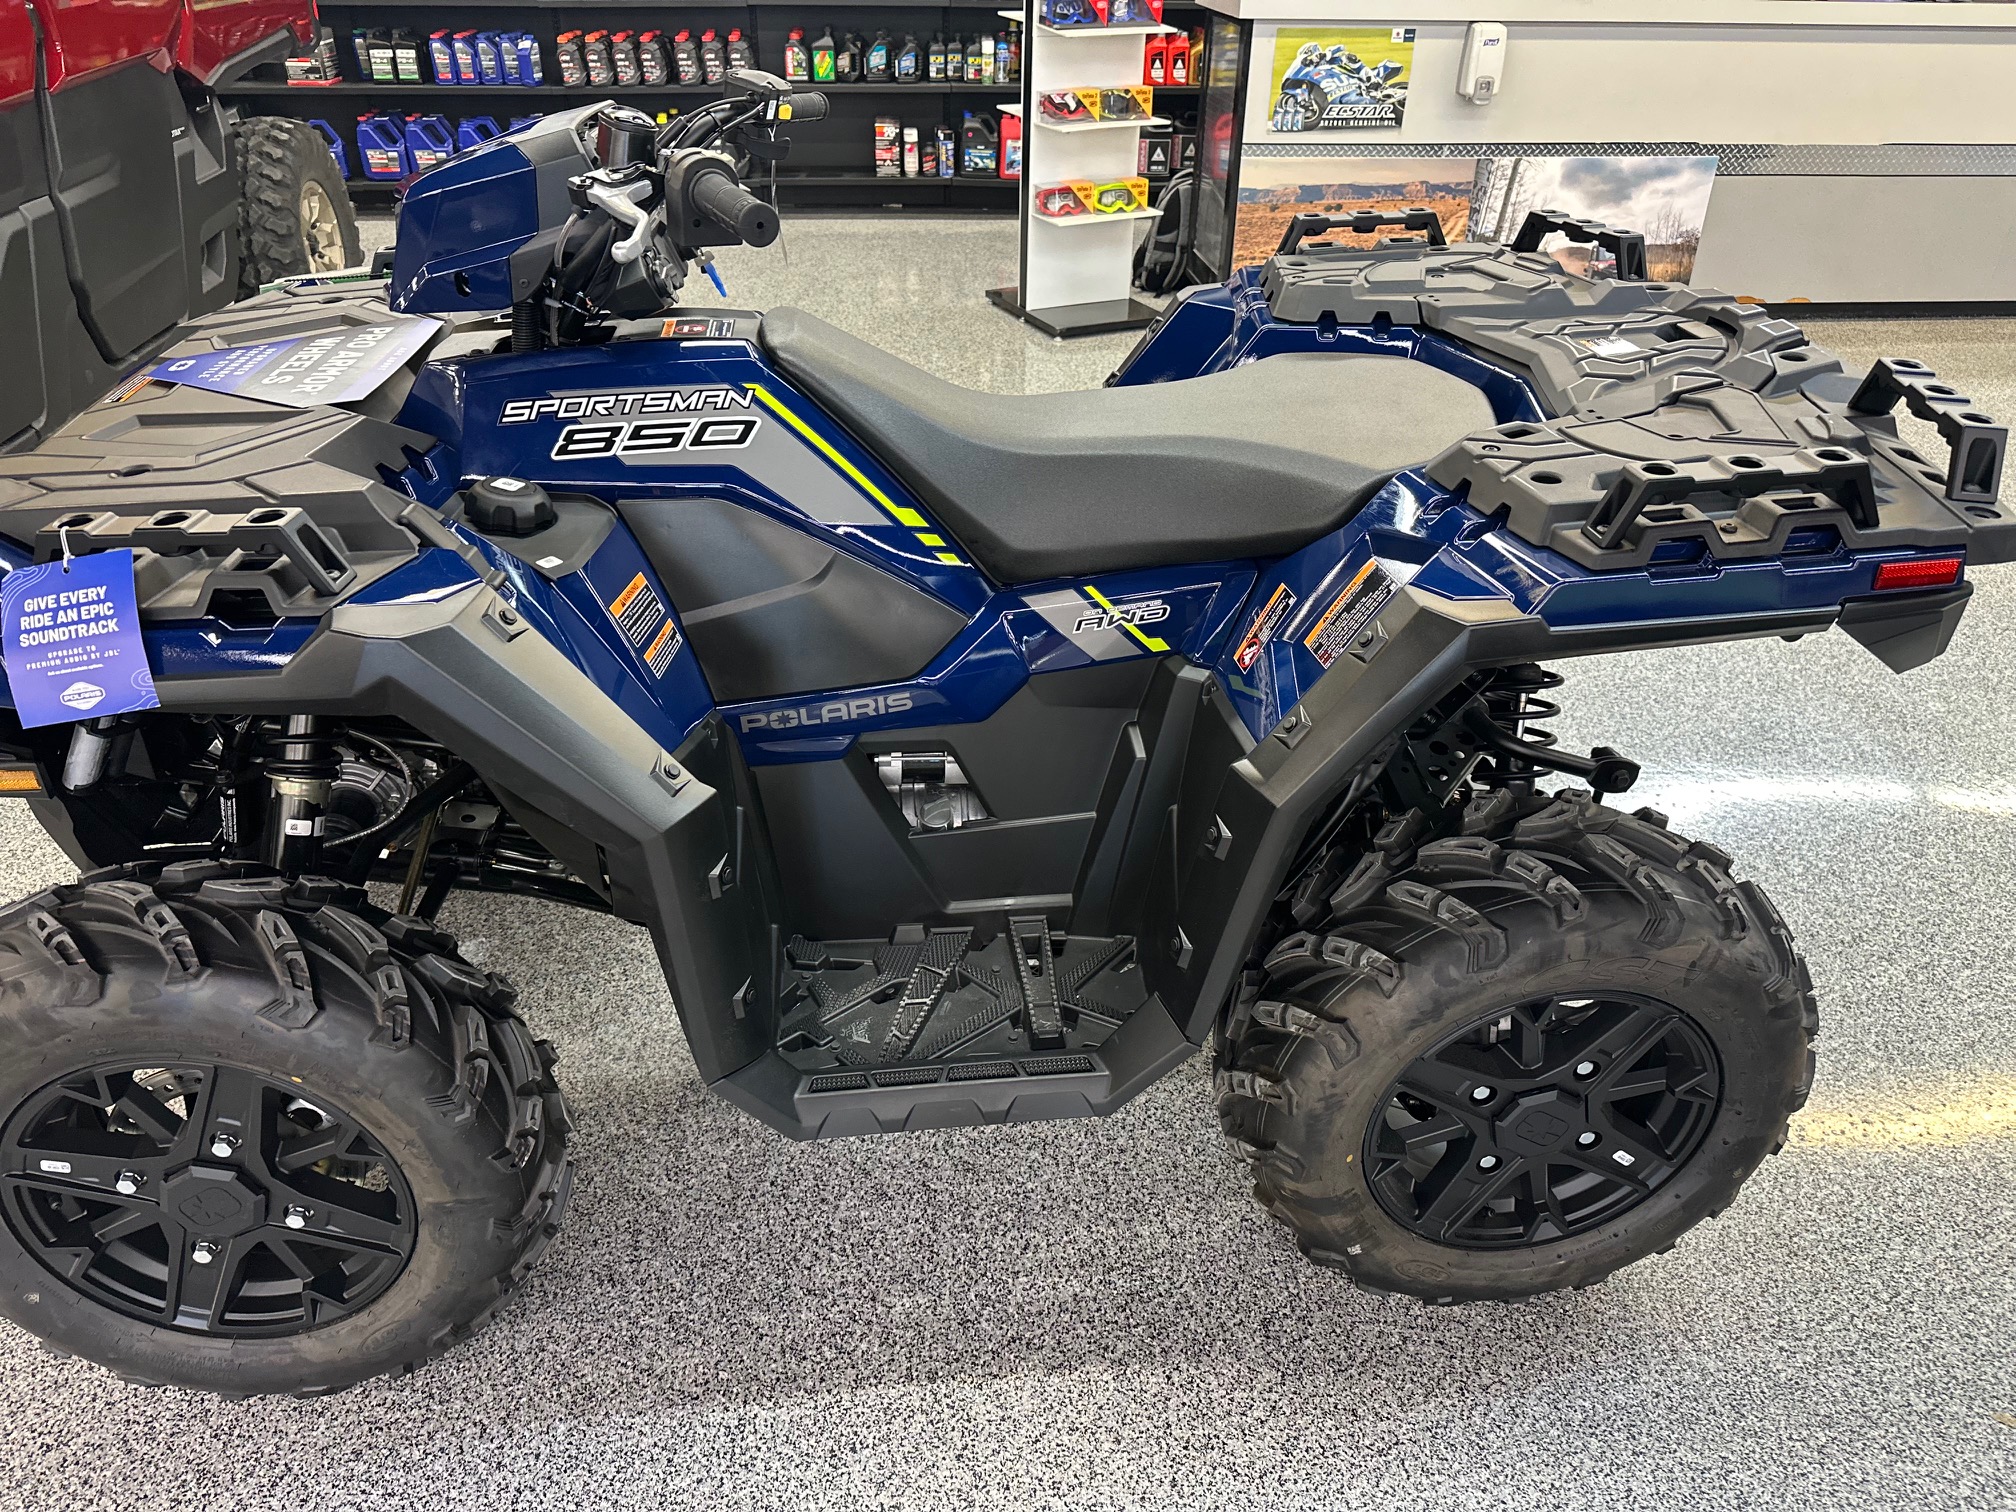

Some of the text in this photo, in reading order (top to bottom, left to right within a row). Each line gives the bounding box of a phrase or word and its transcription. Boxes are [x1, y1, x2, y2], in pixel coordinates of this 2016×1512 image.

[1322, 104, 1396, 118] ECSTAR
[346, 327, 394, 350] PRO
[262, 336, 346, 385] WHEELS
[293, 350, 365, 394] ARMOR
[500, 388, 756, 424] SPORTSMAN
[551, 416, 762, 460] 850
[24, 585, 107, 612] GIVE EVERY
[1328, 582, 1357, 615] WARNING
[20, 602, 114, 631] RIDE AN EPIC
[1072, 605, 1171, 634] AWD
[19, 618, 119, 648] SOUNDTRACK
[26, 659, 61, 670] PREMIUM
[64, 655, 88, 664] AUDIO
[47, 647, 83, 658] UPGRADE
[63, 690, 102, 702] POLARIS
[740, 692, 913, 733] POLARIS
